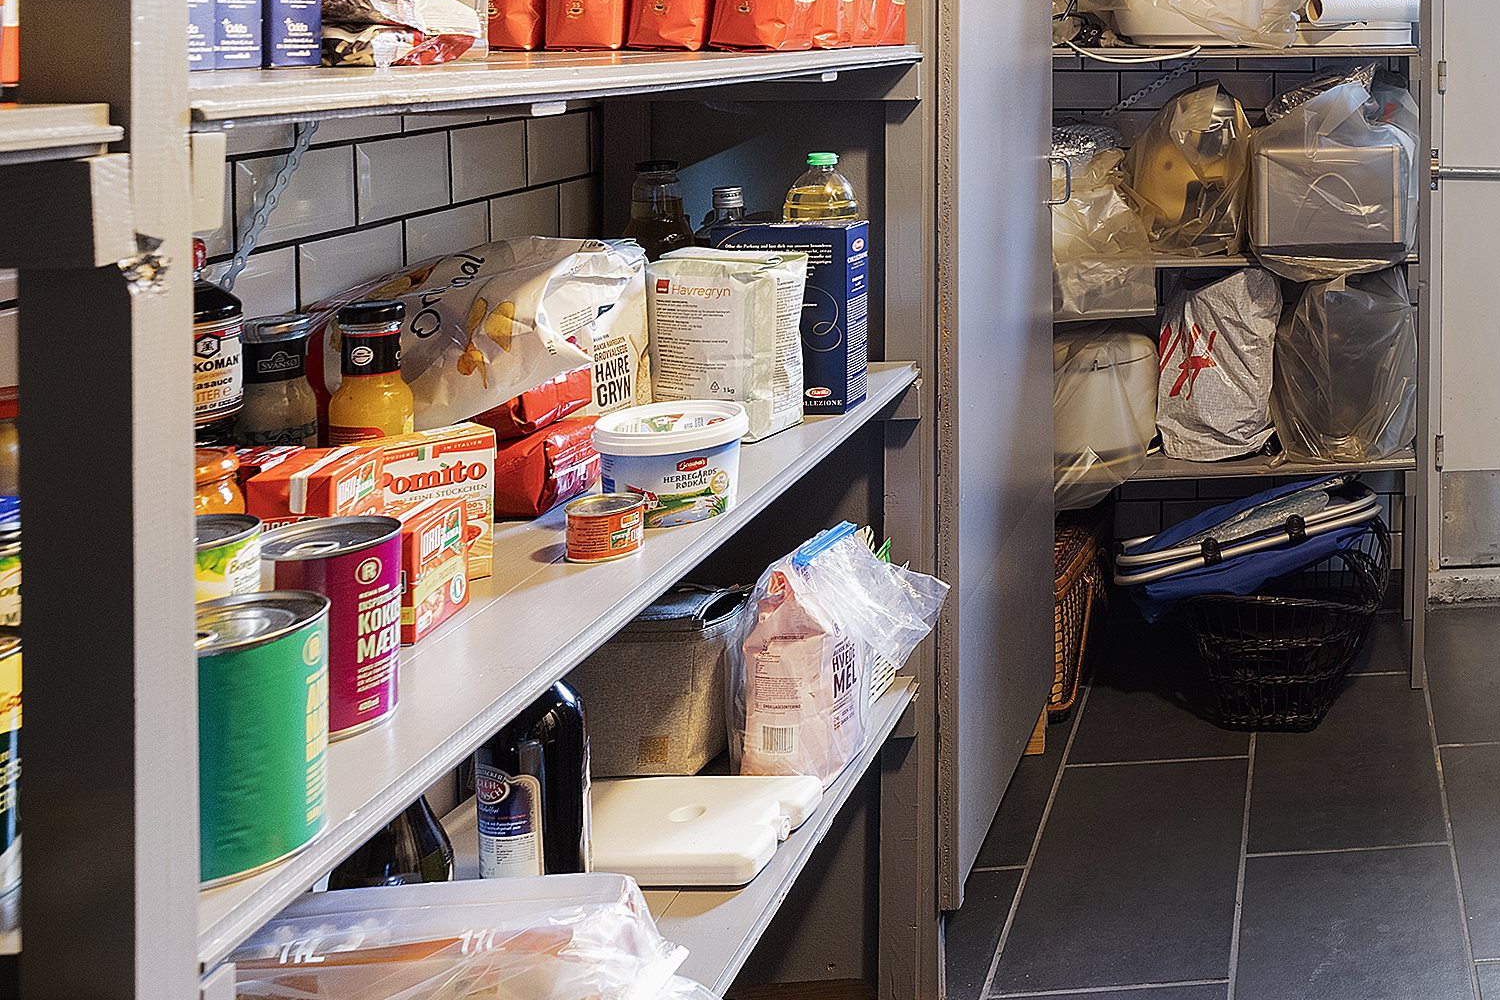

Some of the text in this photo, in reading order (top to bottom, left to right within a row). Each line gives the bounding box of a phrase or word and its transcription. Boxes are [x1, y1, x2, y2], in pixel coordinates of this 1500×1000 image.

[671, 284, 731, 300] Havregryn
[194, 354, 240, 373] KOMAN
[594, 355, 630, 383] HAVRE
[195, 377, 233, 390] asauce
[196, 389, 220, 403] ITER
[596, 374, 631, 408] GRYN
[727, 387, 735, 395] kg
[803, 399, 843, 407] LLEZIONE
[454, 440, 483, 449] ITALIEN
[383, 452, 415, 461] DUZIERT
[663, 467, 718, 484] HERREGÅRDS
[436, 483, 488, 497] STÜCKCHEN
[675, 476, 708, 490] RØDKÅL
[833, 660, 858, 699] MEL
